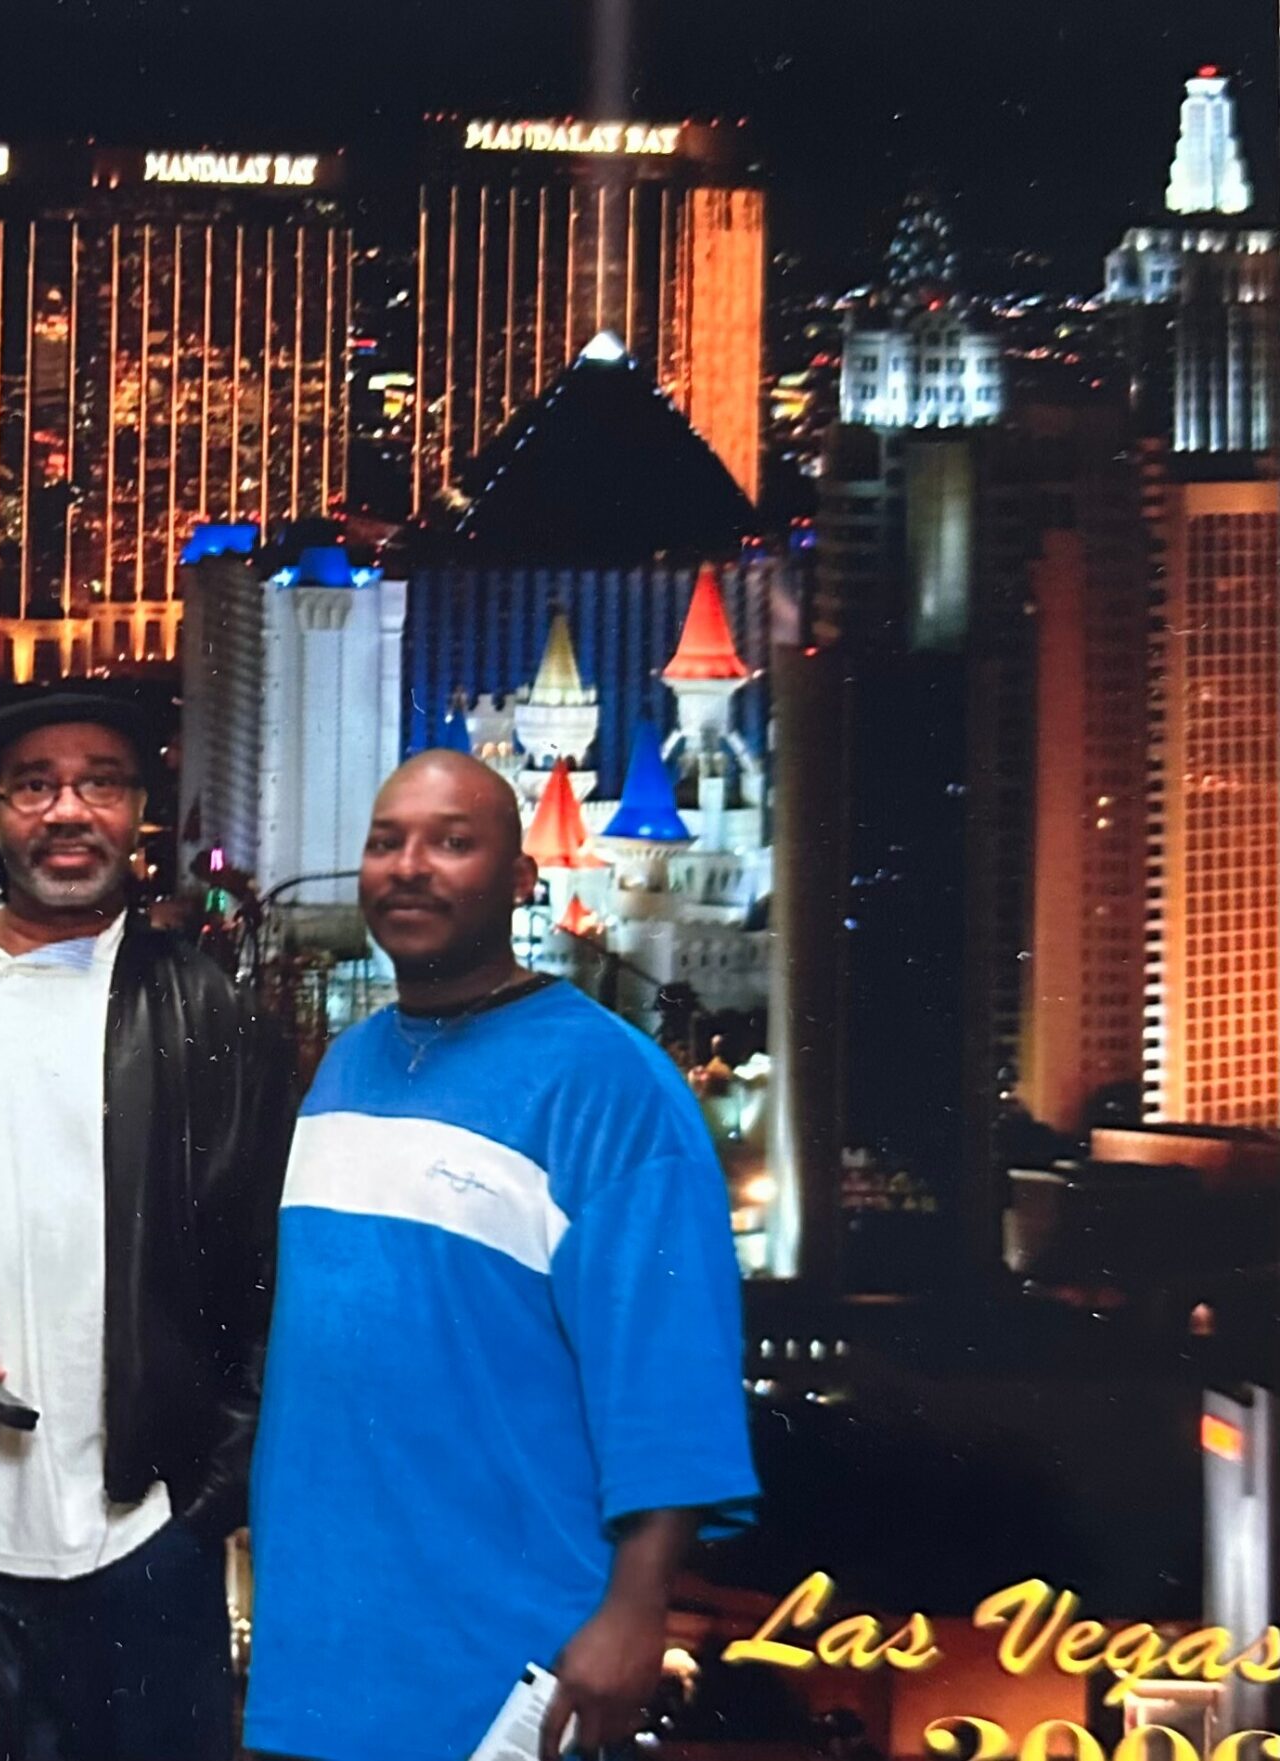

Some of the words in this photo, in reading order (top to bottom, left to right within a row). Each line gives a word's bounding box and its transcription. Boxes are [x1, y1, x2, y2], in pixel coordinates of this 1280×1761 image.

[465, 122, 621, 152] MANDALAY
[624, 125, 681, 154] BAY
[144, 153, 271, 184] MANDALAY
[273, 154, 318, 185] BAY
